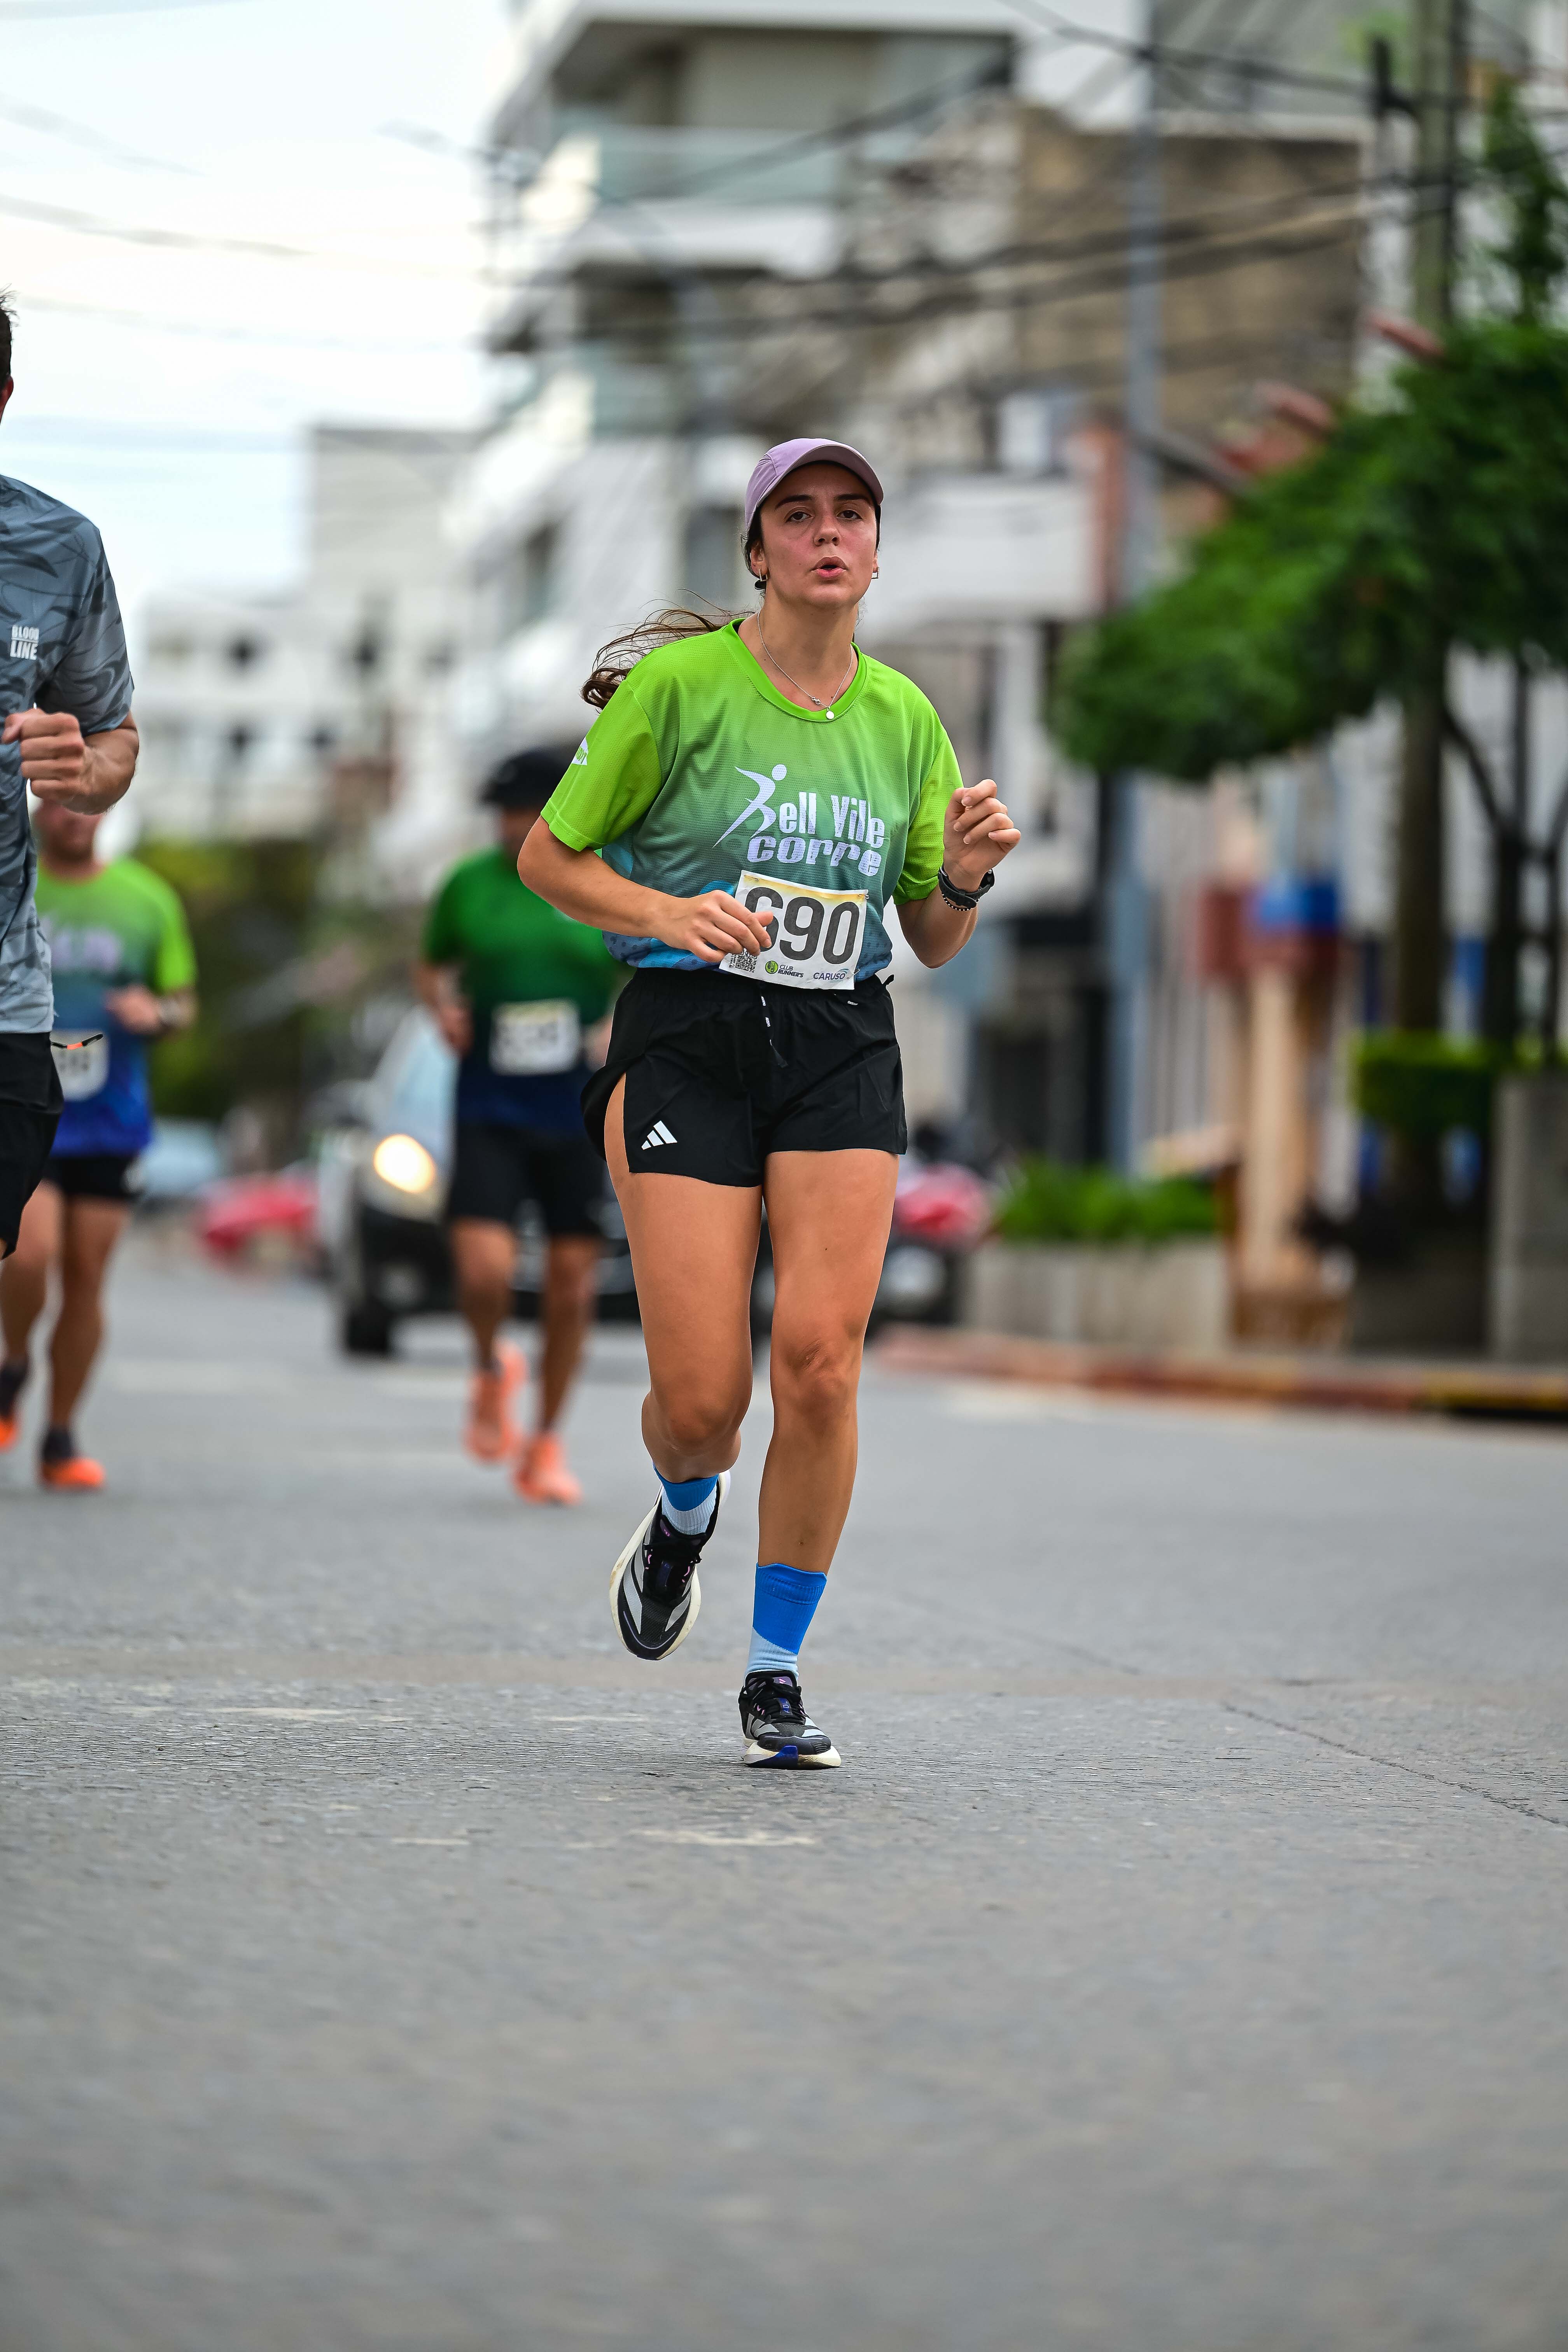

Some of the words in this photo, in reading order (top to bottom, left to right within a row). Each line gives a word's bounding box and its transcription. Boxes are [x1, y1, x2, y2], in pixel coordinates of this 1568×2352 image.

[10, 640, 38, 660] LINE
[747, 836, 882, 877] corre
[778, 969, 804, 978] RUNNER'S
